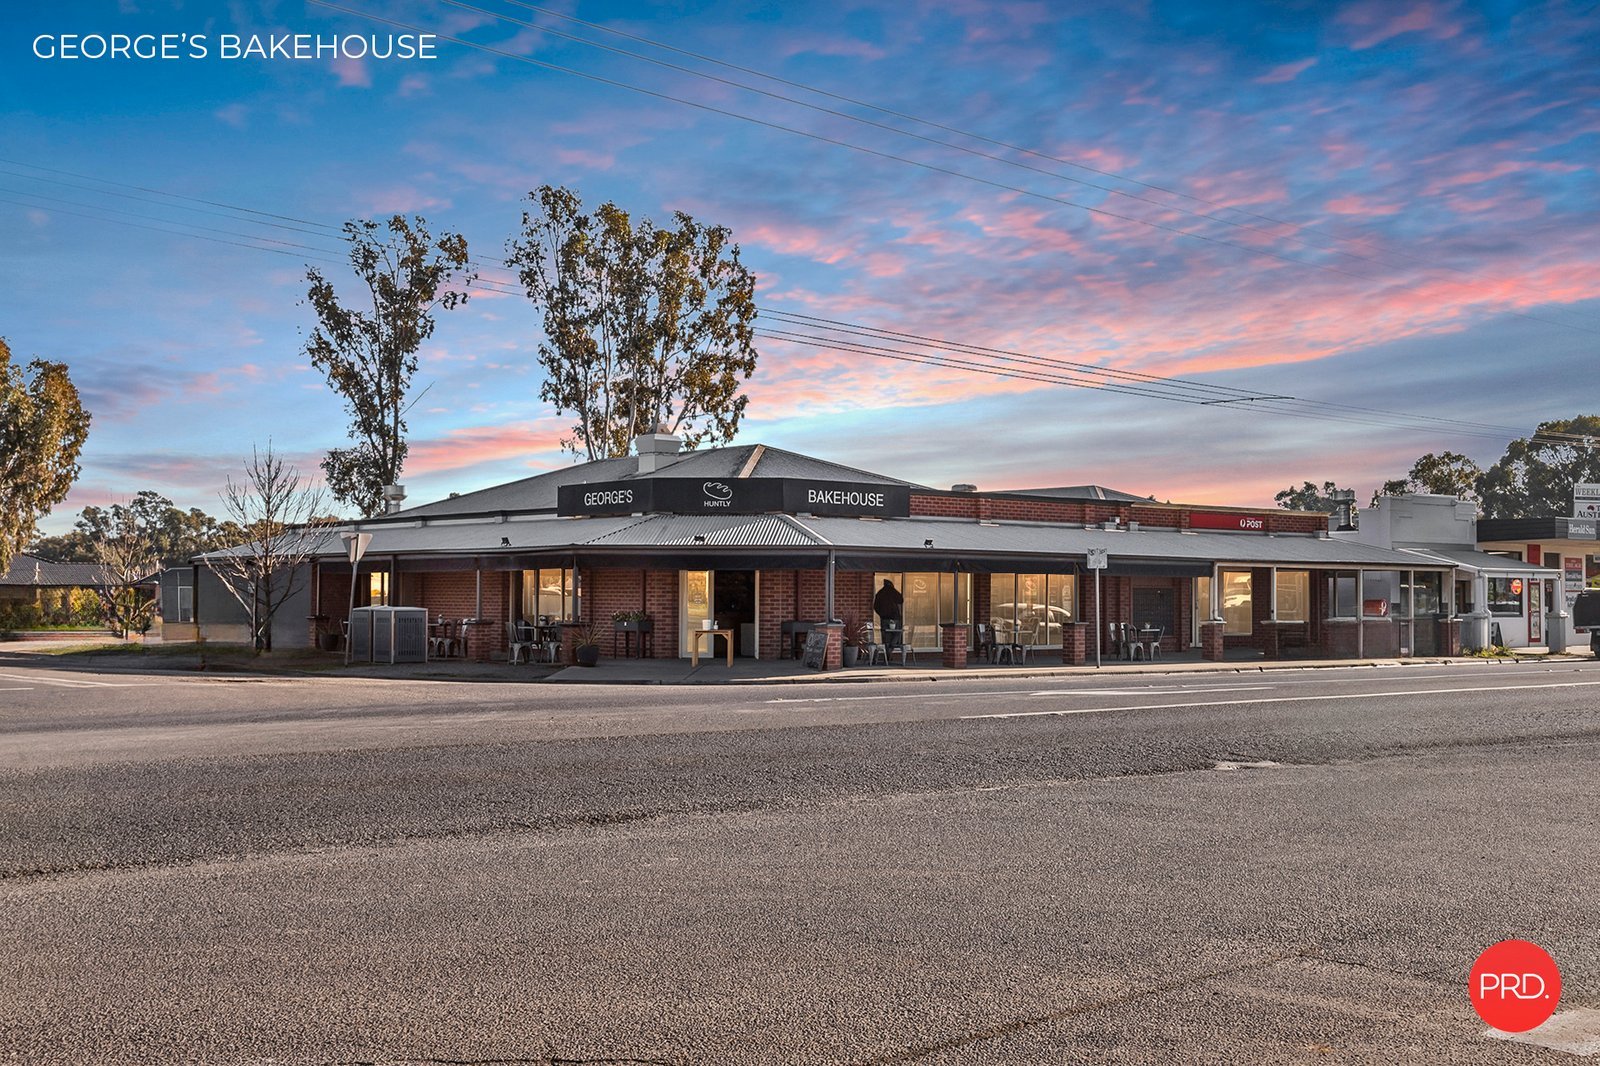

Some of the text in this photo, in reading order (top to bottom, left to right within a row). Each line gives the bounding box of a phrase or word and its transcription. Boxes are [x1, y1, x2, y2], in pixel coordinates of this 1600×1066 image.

[584, 490, 633, 506] GEORGE'S
[808, 489, 884, 507] BAKEHOUSE
[1246, 520, 1263, 528] POST
